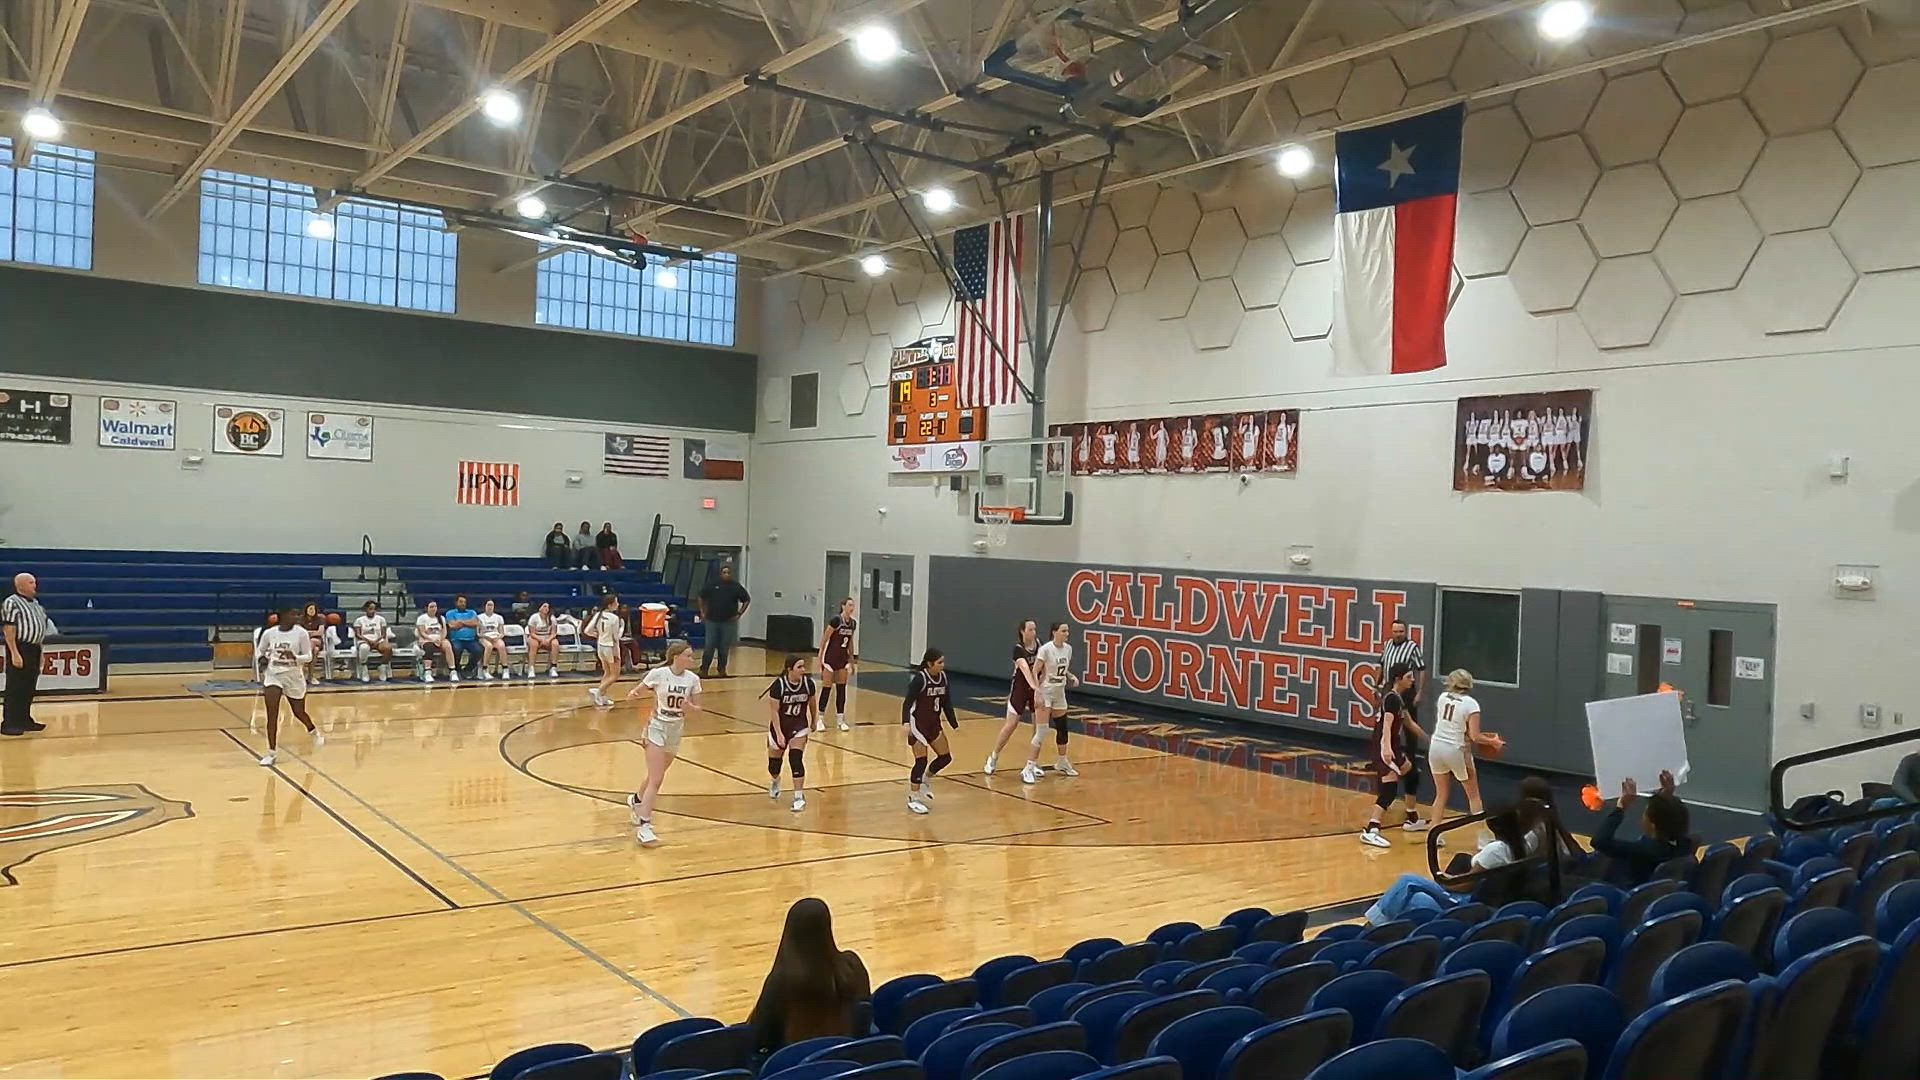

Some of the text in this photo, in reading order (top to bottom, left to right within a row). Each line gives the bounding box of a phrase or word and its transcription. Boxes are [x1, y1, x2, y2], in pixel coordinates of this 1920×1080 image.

[900, 381, 911, 402] 19
[930, 393, 937, 407] 3
[102, 419, 173, 436] Walmart
[920, 421, 933, 436] 22
[110, 436, 165, 446] Caldwell
[239, 433, 259, 447] BC
[460, 473, 516, 491] HPND
[1067, 570, 1424, 654] CALDWELL
[41, 649, 92, 676] ETS
[668, 684, 688, 694] LADY
[1083, 630, 1385, 731] HORNETS
[1443, 703, 1455, 722] 11
